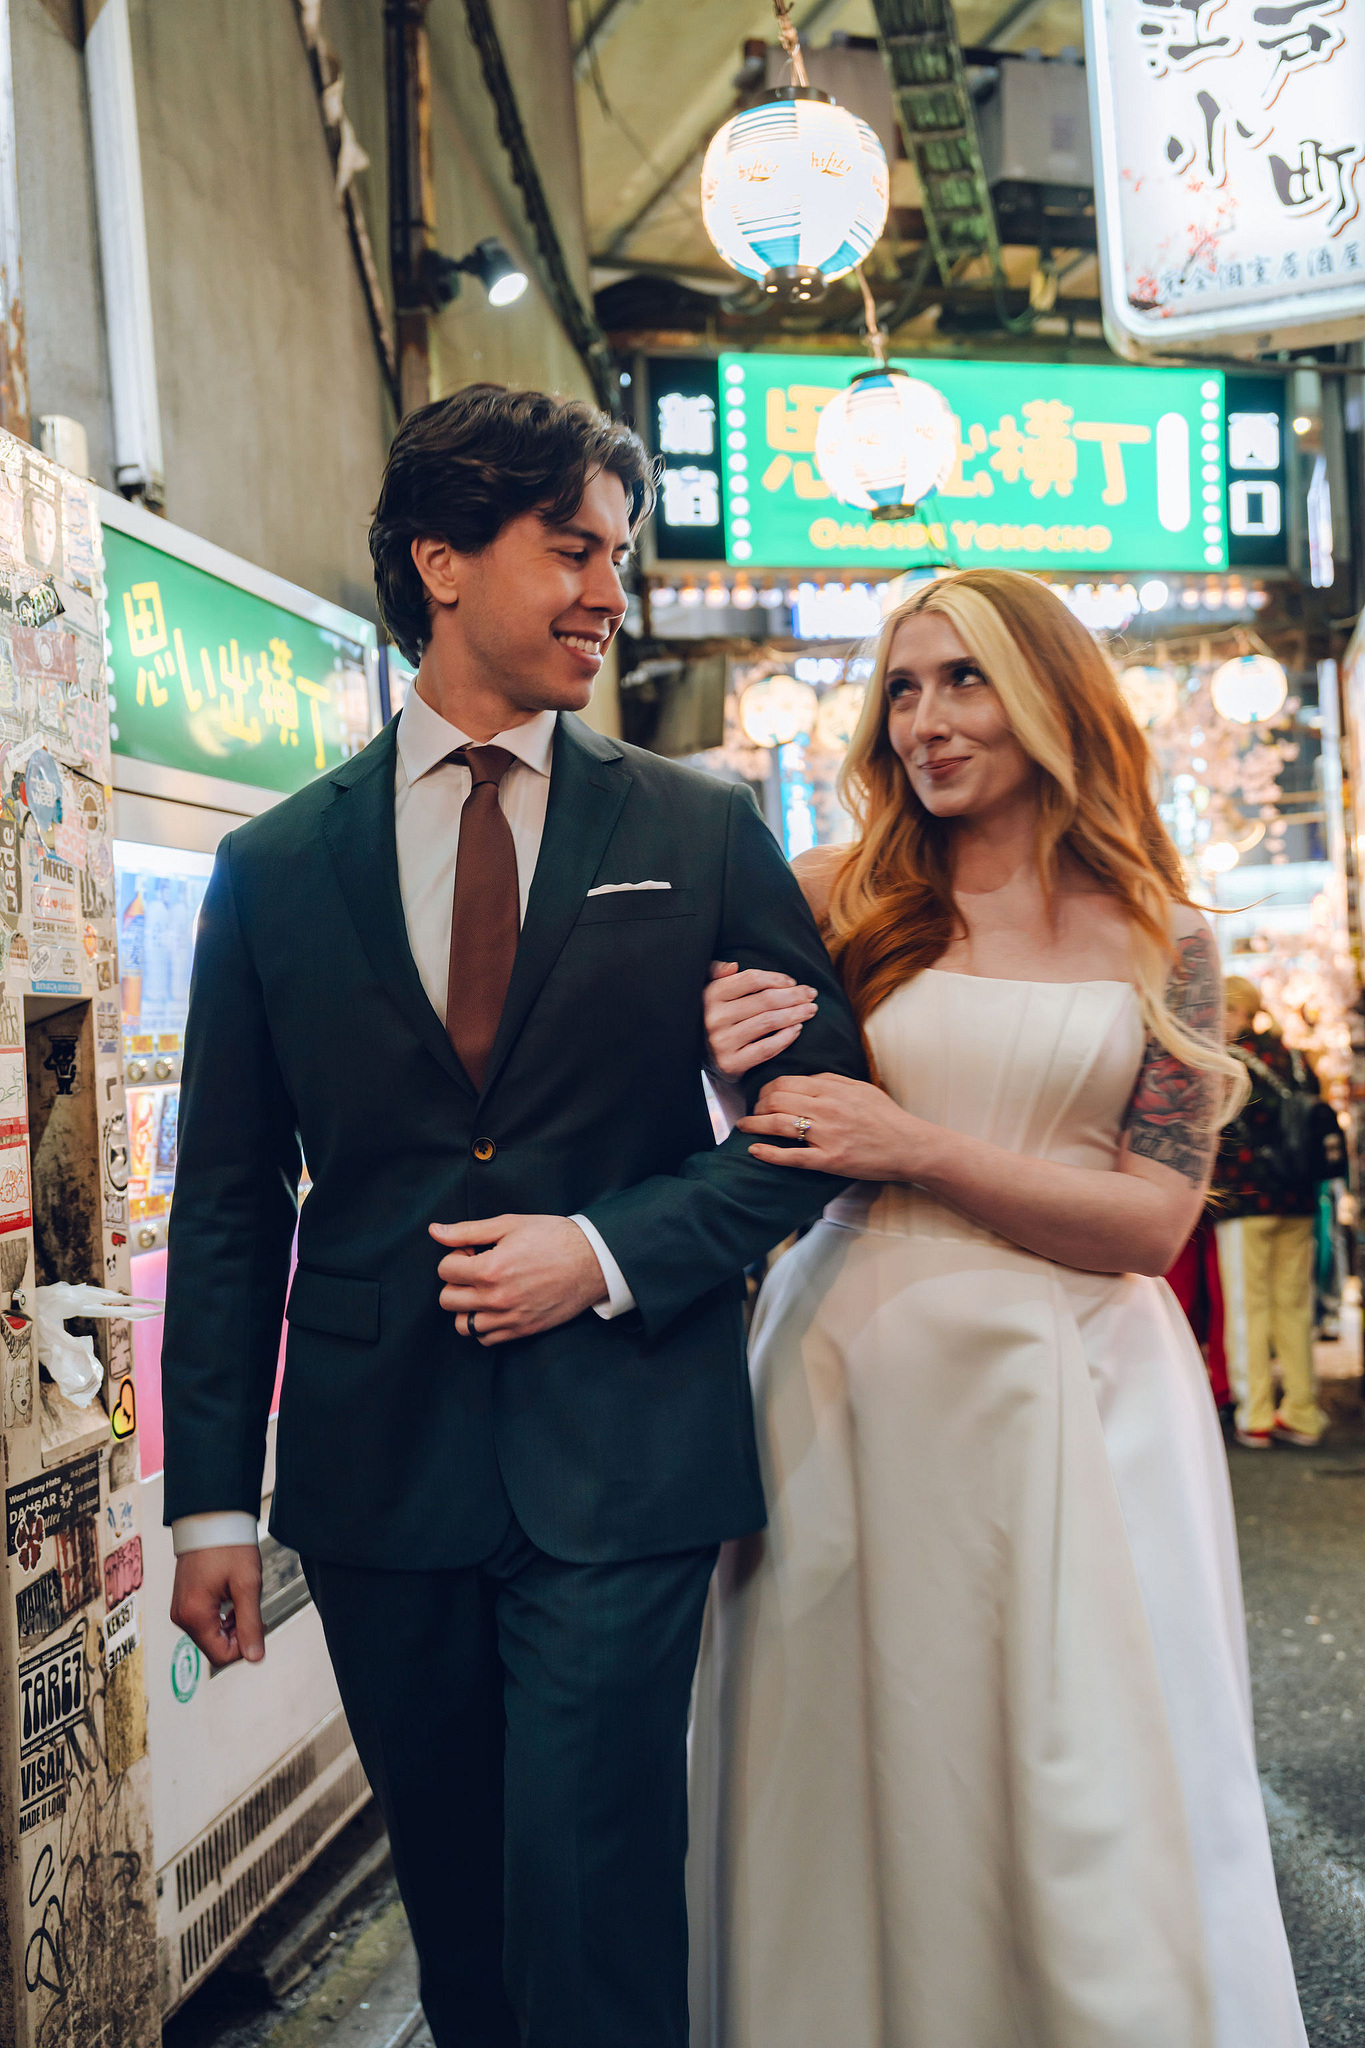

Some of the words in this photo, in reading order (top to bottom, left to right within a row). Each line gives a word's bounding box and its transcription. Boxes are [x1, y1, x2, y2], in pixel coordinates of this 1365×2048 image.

[1167, 90, 1357, 227] 小町
[761, 384, 1151, 506] 思横丁
[122, 581, 331, 770] 思い出横丁
[0, 827, 19, 912] Jade
[42, 857, 74, 885] MKUE
[9, 1490, 28, 1506] Wear
[28, 1483, 46, 1500] Many
[46, 1476, 62, 1491] Hats
[19, 1806, 41, 1835] MADE
[41, 1802, 47, 1821] U
